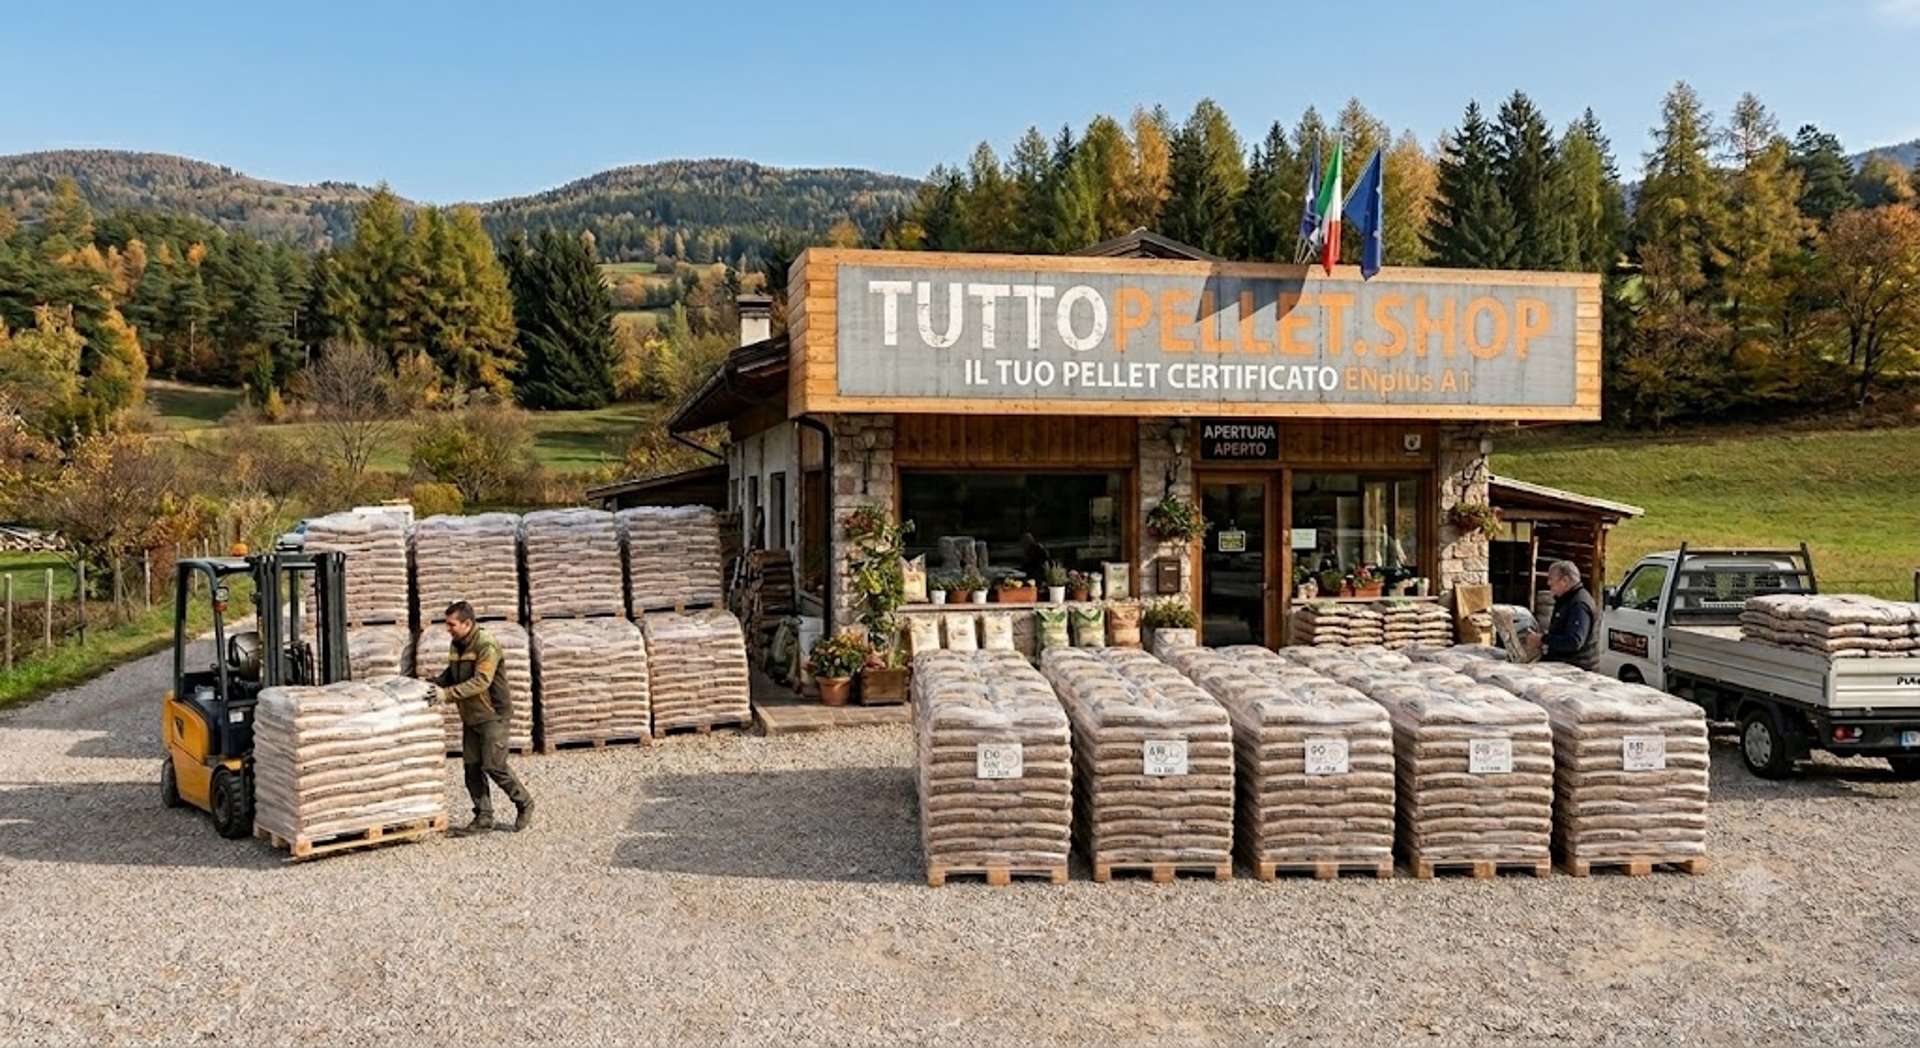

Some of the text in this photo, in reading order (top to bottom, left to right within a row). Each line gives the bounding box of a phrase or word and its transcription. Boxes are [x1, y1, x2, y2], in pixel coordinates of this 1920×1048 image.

[868, 280, 1553, 362] TUTTOPELLET.SHOP
[964, 359, 1471, 395] IL TUO PELLET CERTIFICATO ENplus A1
[1204, 424, 1276, 439] APERTURA
[1214, 441, 1267, 456] APERTO
